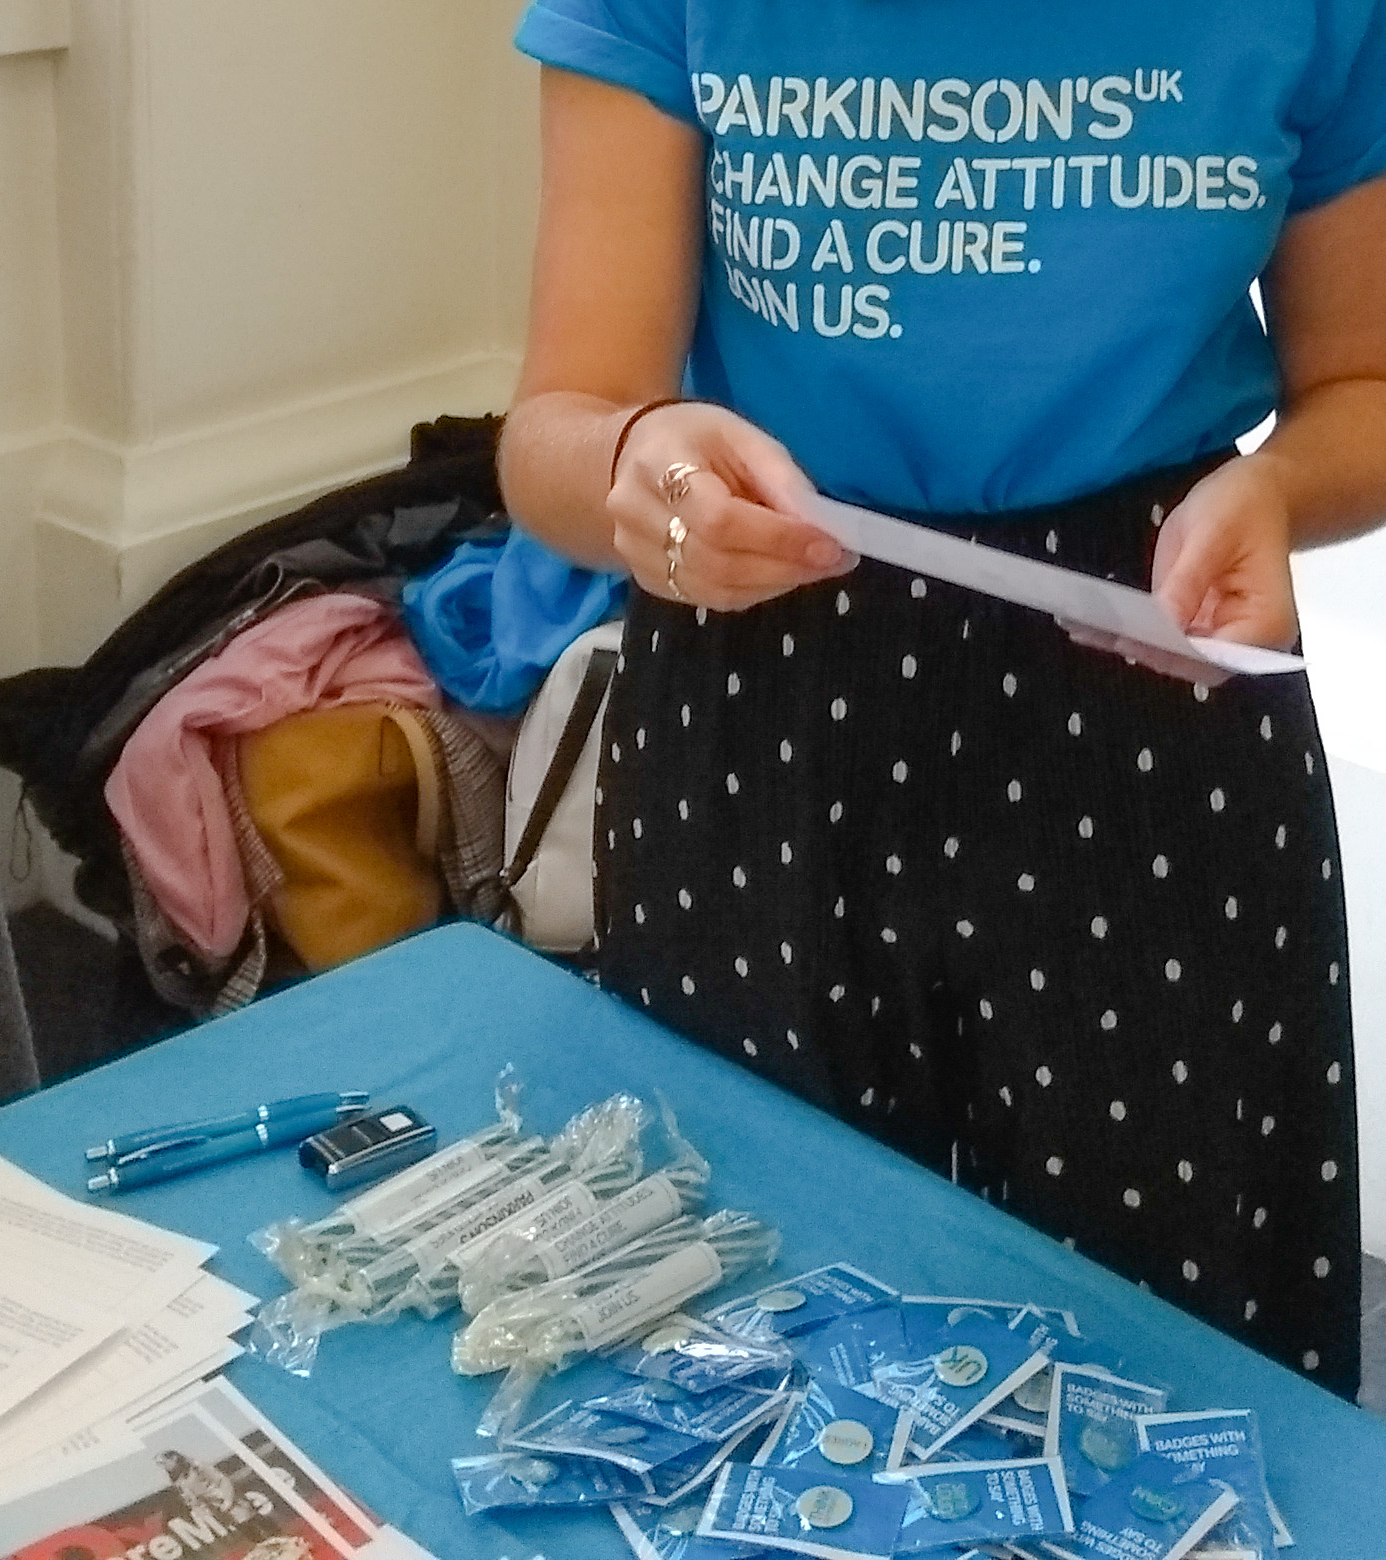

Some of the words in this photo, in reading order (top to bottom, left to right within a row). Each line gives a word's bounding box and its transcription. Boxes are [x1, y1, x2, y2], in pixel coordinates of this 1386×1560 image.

[710, 146, 922, 211] CHANGE
[934, 154, 1268, 212] ATTITUDES.
[711, 197, 802, 272] FIND
[811, 219, 854, 274] A
[865, 219, 1042, 275] CURE.
[812, 283, 904, 339] US.
